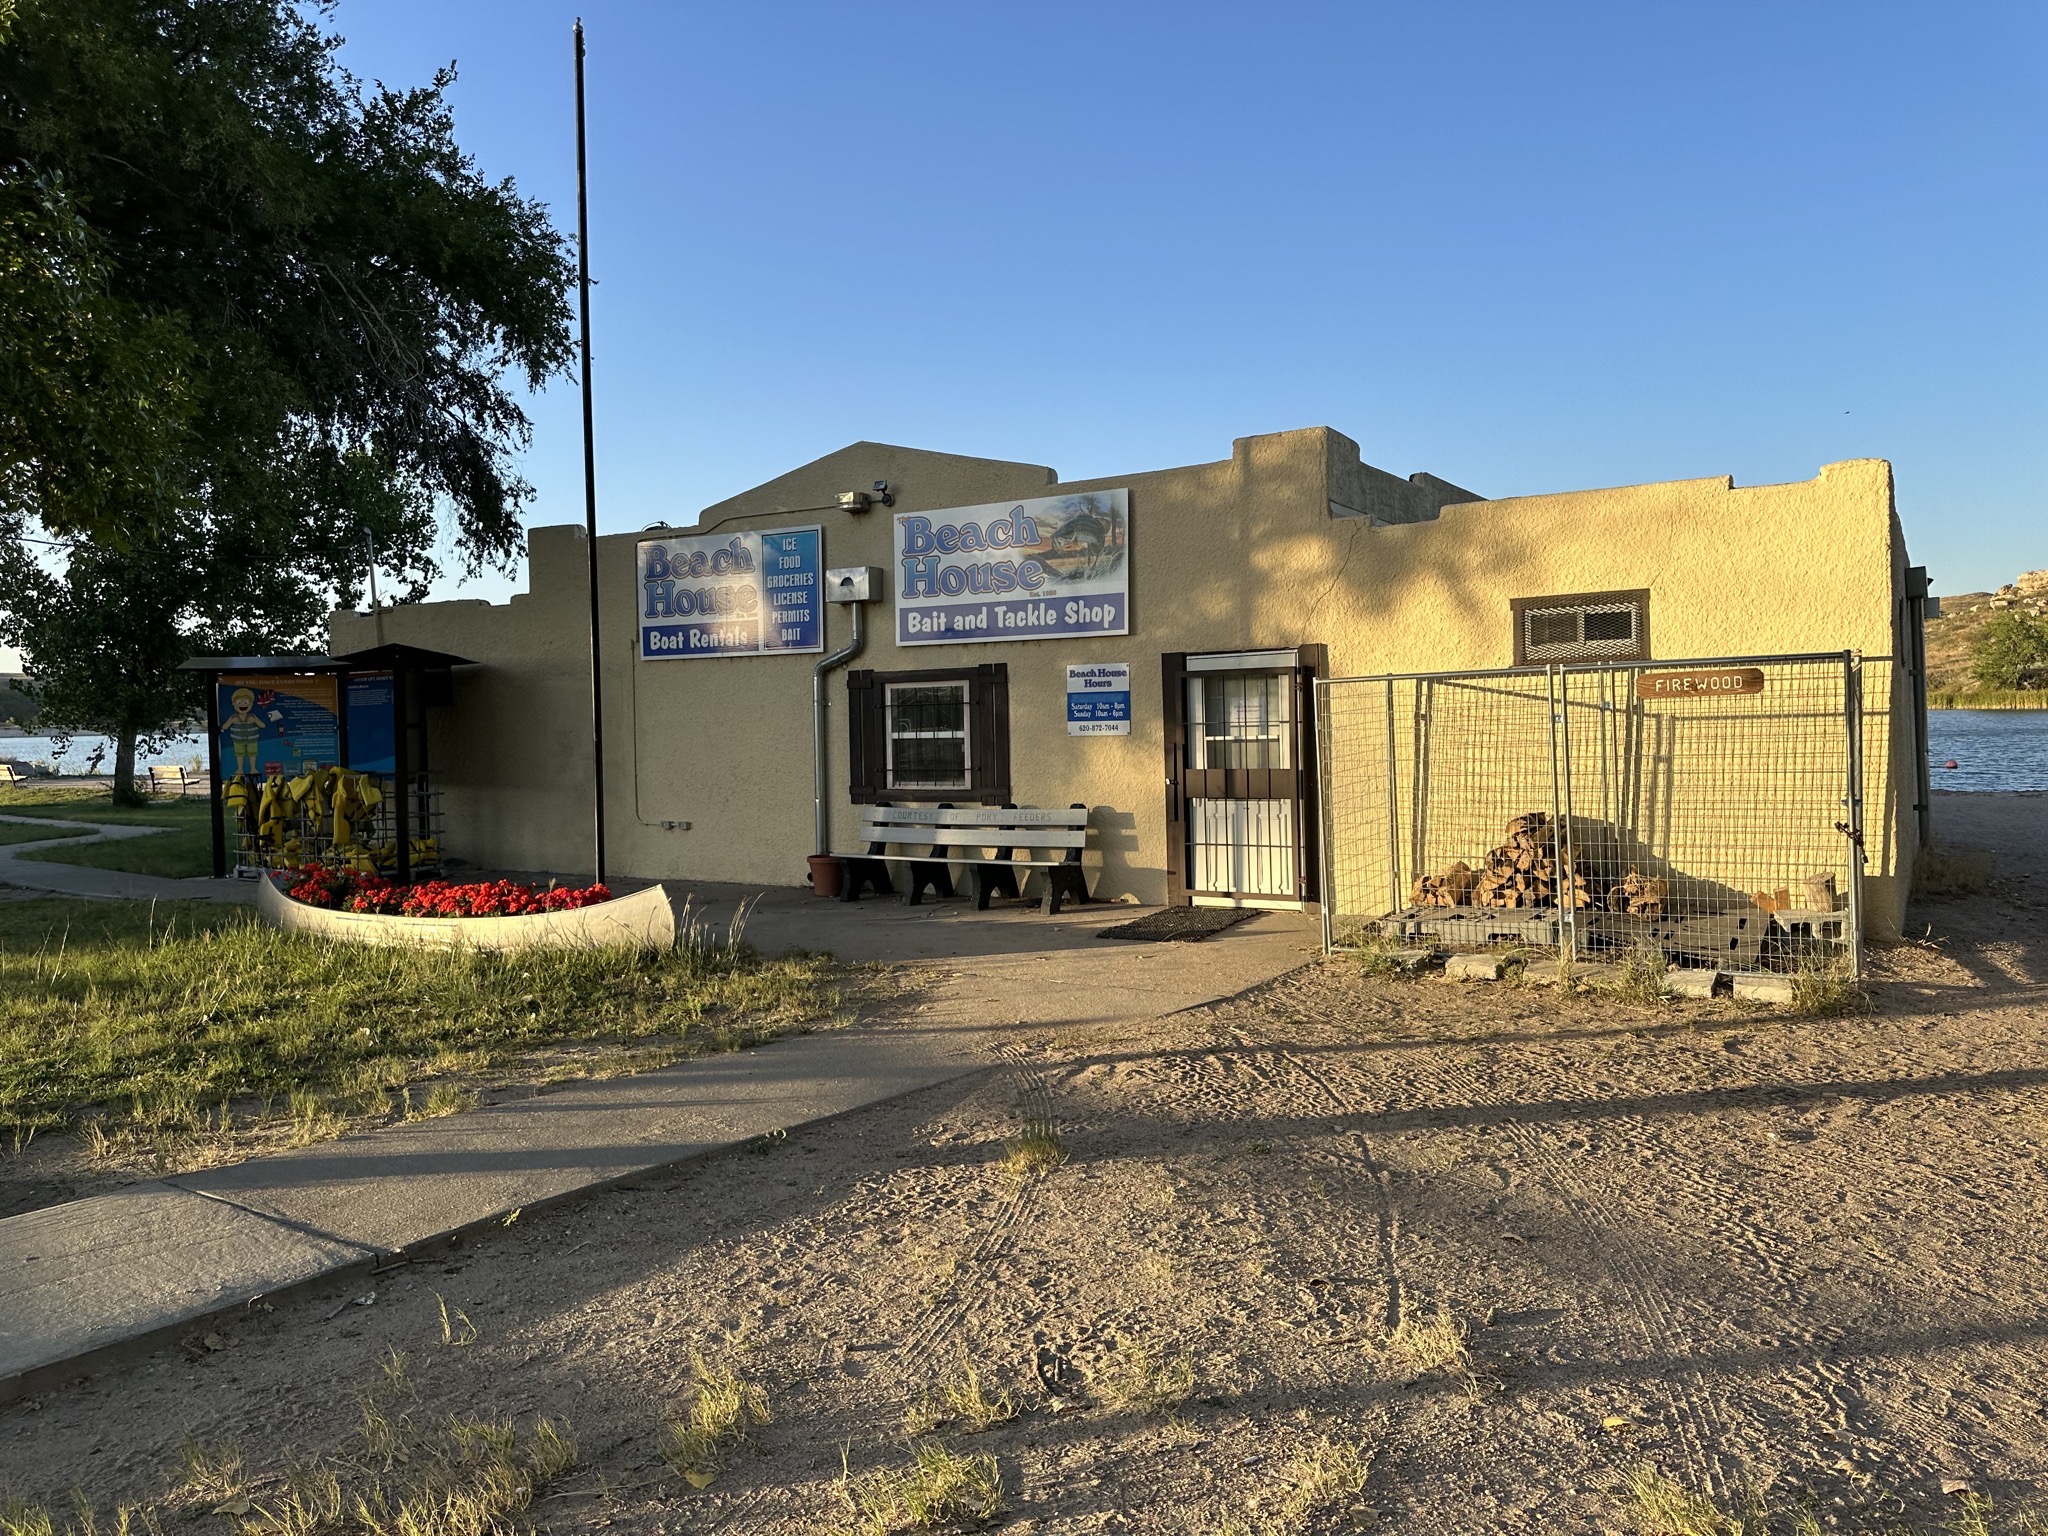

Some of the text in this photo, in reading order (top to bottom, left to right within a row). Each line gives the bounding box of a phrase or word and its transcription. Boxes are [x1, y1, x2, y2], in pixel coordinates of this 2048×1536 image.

[902, 505, 1041, 557] Beach
[783, 538, 797, 551] ICE
[644, 537, 755, 581] Beach
[779, 556, 800, 569] FOOD
[767, 573, 814, 588] GROCERIES
[901, 556, 1045, 599] House
[644, 580, 758, 618] House
[773, 591, 807, 606] LICENSE
[772, 610, 810, 624] PERMITS
[907, 600, 1116, 634] Bait and Tackle Shop
[649, 626, 748, 650] Boat Rentals
[781, 628, 800, 641] BAIT
[1069, 669, 1127, 678] Beach House
[1084, 679, 1112, 688] Hours
[1655, 675, 1743, 692] FIREWOOD
[1071, 702, 1092, 710] Saturday
[1113, 710, 1124, 718] 6pm
[892, 811, 1052, 821] COURTESY OF POKY FEEDERS
